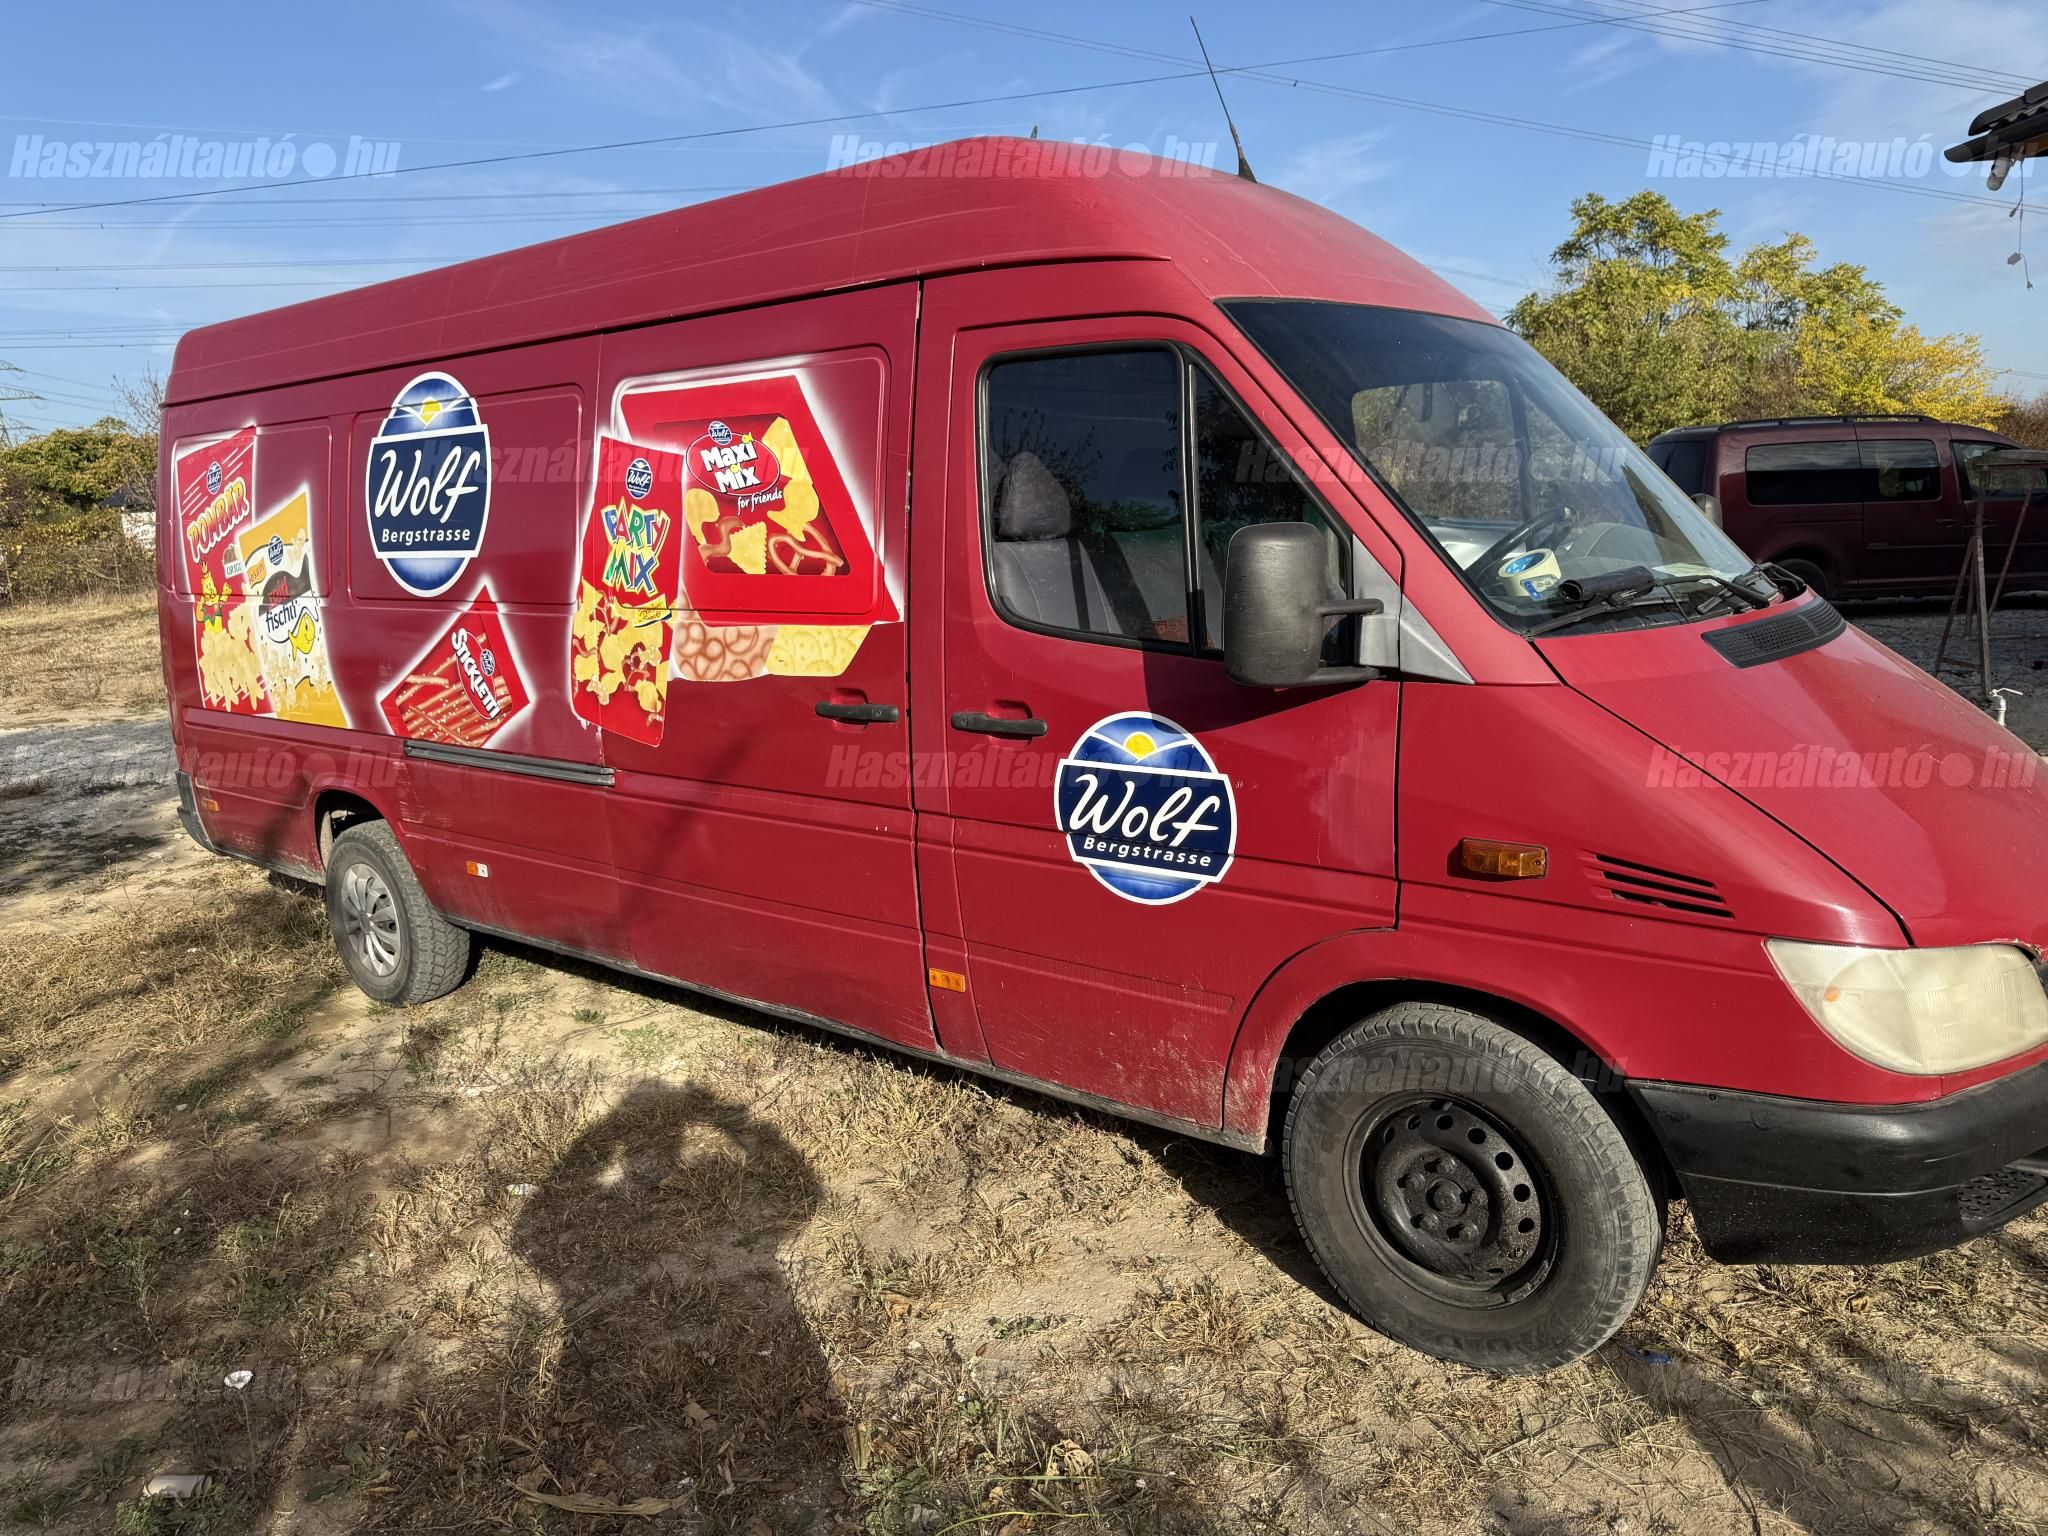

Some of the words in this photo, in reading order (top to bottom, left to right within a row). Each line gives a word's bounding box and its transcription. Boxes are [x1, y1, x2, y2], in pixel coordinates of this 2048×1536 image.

[700, 434, 758, 472] Maxi
[375, 446, 481, 524] Wolf
[628, 470, 651, 488] Wolf
[714, 464, 762, 494] Mix
[737, 497, 751, 516] for
[750, 487, 783, 512] friends
[381, 528, 471, 546] Bergstrasse
[602, 497, 670, 556] PARTY
[603, 547, 659, 597] MIX
[266, 600, 298, 633] fischli
[452, 628, 501, 719] STICKLETTI
[1069, 774, 1221, 847] Wolf
[1084, 837, 1211, 867] Bergstrasse
